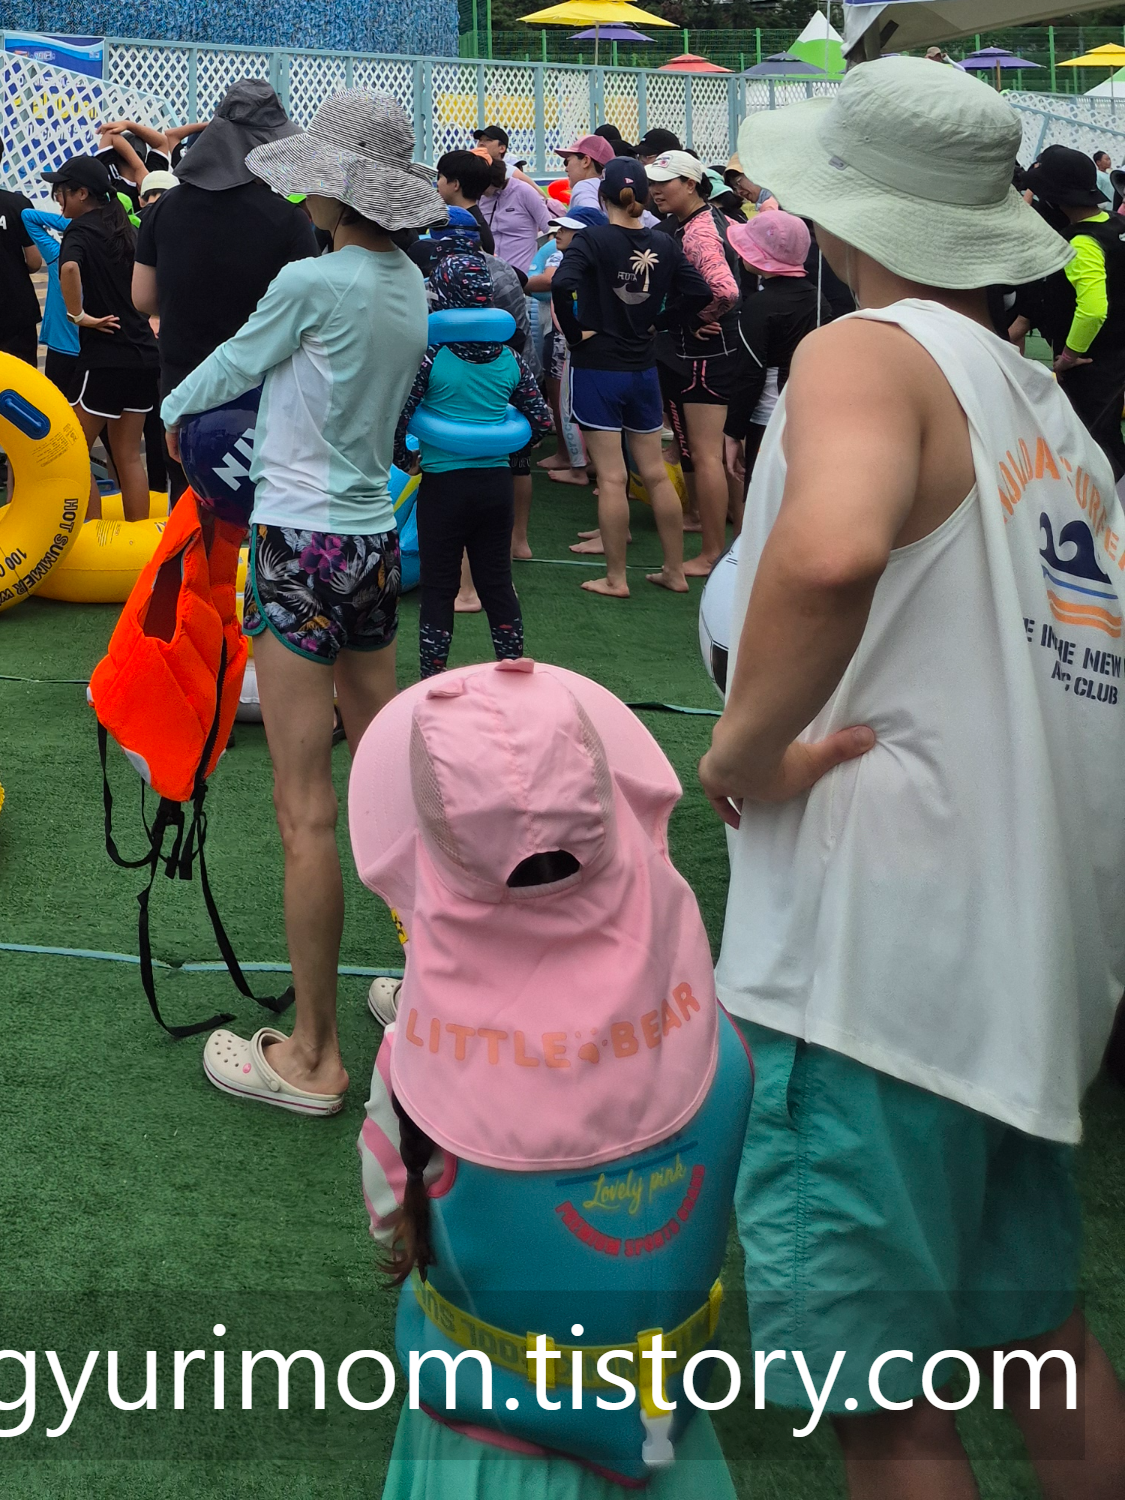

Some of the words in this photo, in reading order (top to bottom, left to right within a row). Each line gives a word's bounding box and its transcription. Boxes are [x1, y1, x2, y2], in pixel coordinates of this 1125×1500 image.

[668, 399, 692, 459] AIRWALK
[59, 498, 80, 534] HOT
[4, 547, 28, 571] 100
[12, 533, 70, 596] SUMMER
[1082, 646, 1122, 679] NEW
[1073, 676, 1119, 705] CLUB
[405, 1007, 572, 1069] LITTLE
[609, 981, 702, 1059] BEAR
[582, 1168, 643, 1215] Lovely
[648, 1152, 687, 1204] pink
